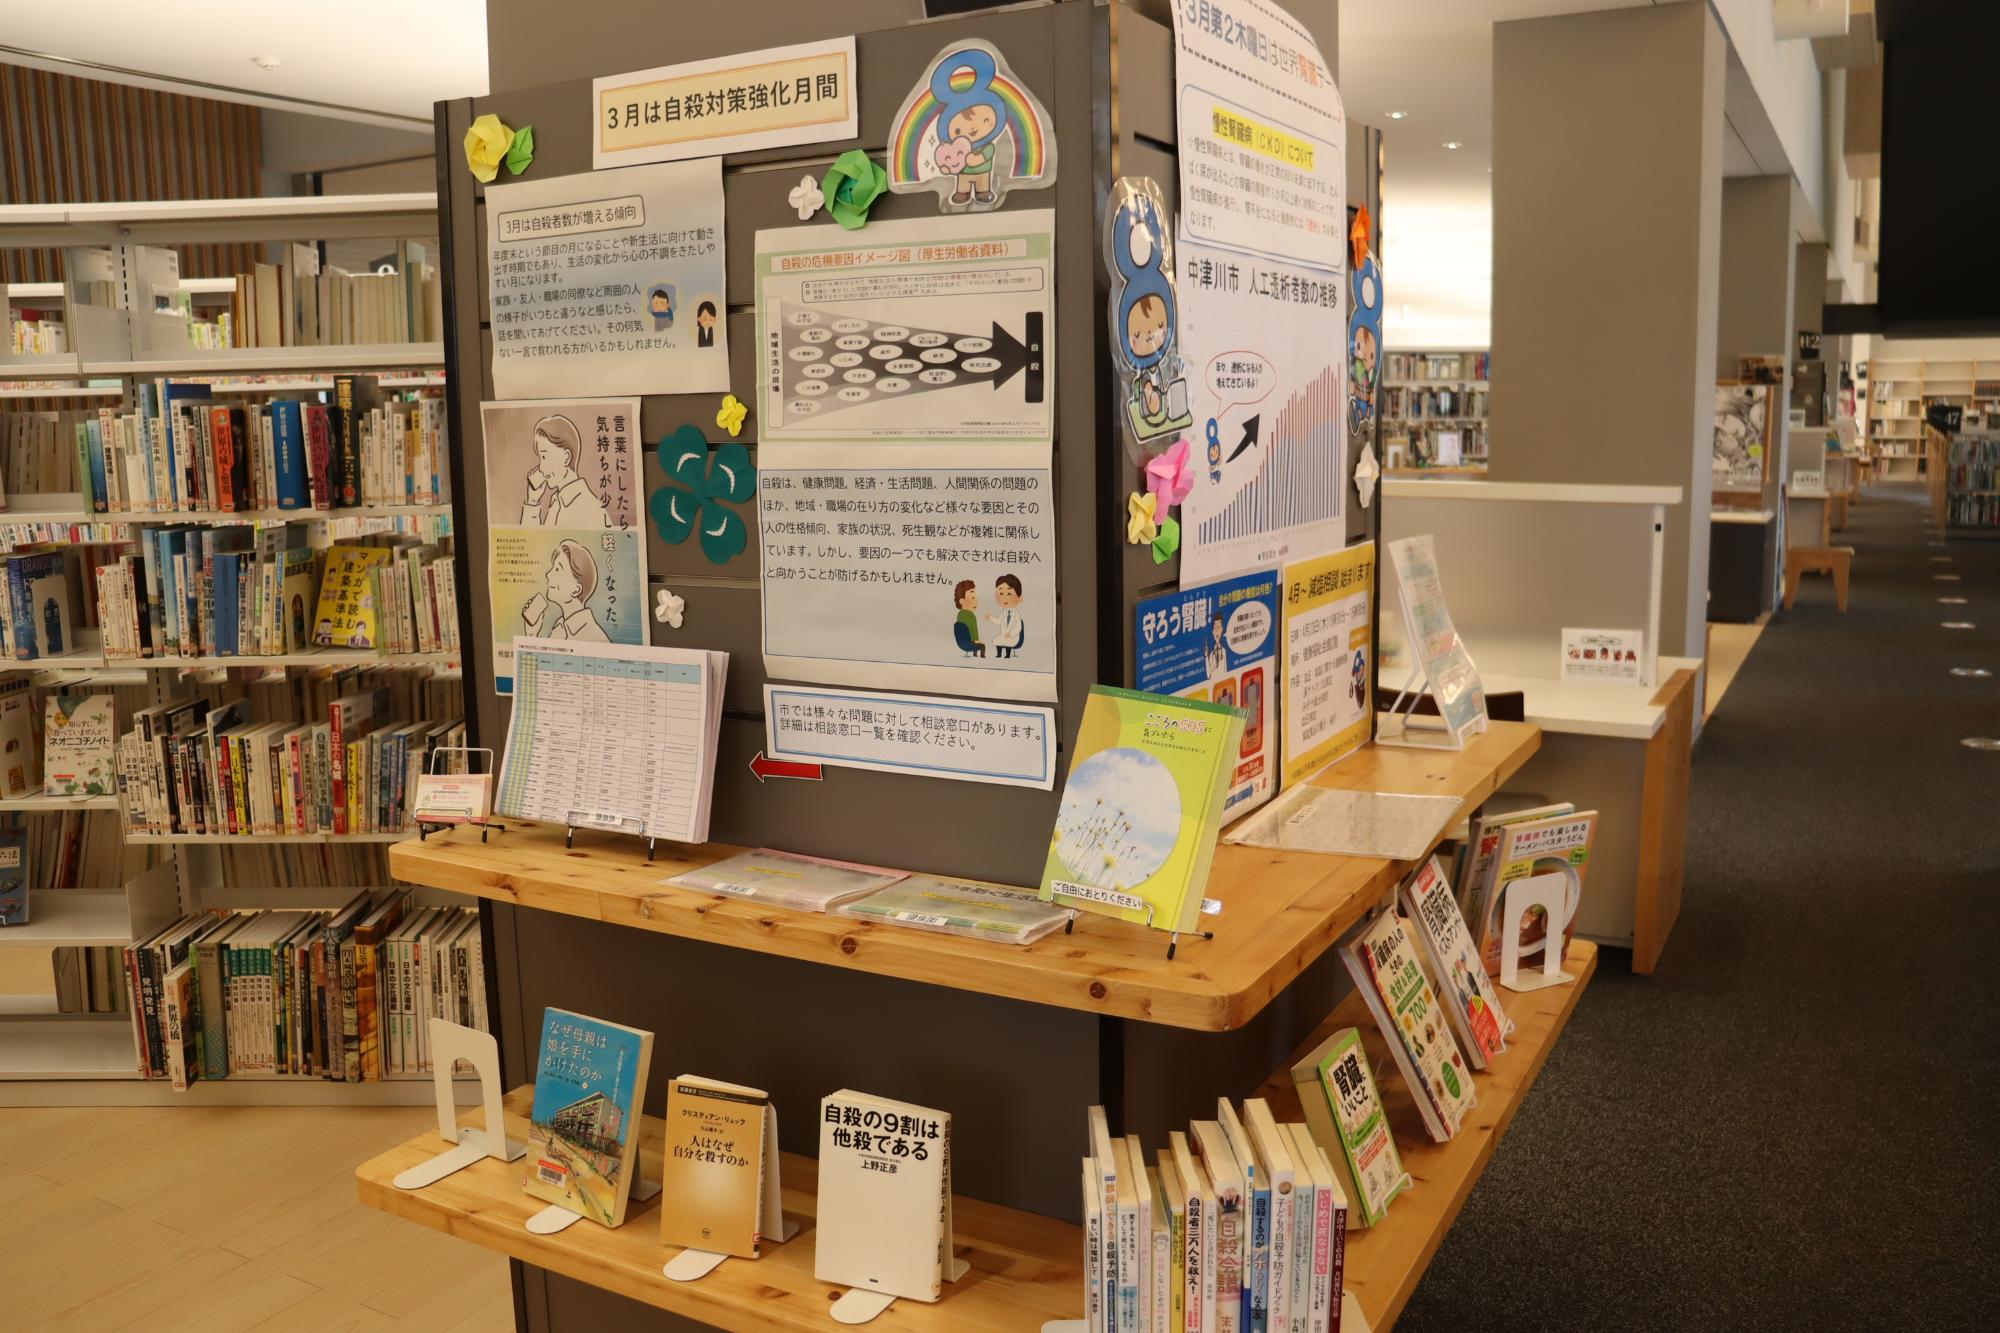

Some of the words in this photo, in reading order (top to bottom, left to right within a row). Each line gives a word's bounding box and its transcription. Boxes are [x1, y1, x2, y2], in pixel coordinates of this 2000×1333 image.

[506, 205, 636, 234] 3月は自殺者数が増える傾向
[781, 243, 1010, 271] 自殺の危機要因イメージ図（厚生労働省資料）
[495, 272, 563, 288] すい月になります。
[1187, 256, 1240, 294] 中津川市
[1249, 267, 1338, 310] 人工透析者数の推移
[496, 302, 637, 324] の様子がいつもと違うなと感じたら、
[498, 320, 643, 342] 話を聞いてあげてください。その何気
[770, 332, 780, 392] 地域生活の現場
[763, 498, 1040, 515] ほか、地域・職場の在り方の変化など様々な要因とその
[765, 521, 1040, 540] 人の性格傾向、家族の状況、死生観などが複雑に関係し
[766, 544, 1041, 564] ています。しかし、要因の一つでも解決できれば自殺へ
[346, 551, 368, 629] マンガで読む
[767, 566, 953, 586] と向かうことが防げるかもしれません。
[332, 561, 354, 629] 建築基準法
[779, 703, 1041, 742] 市では様々な問題に対して相談窓口があります。
[780, 717, 976, 751] 詳細は相談窓口一覧を確認ください。
[48, 736, 110, 747] ネオニコチノイド
[1053, 881, 1143, 908] ご自由におとりください
[1408, 996, 1427, 1025] 700
[549, 1020, 608, 1048] なぜ母親は
[546, 1038, 592, 1061] 娘を手に
[544, 1055, 602, 1081] かけたのか
[681, 1108, 746, 1126] クリスティアン・リュック
[824, 1103, 940, 1140] 自殺の9割は
[690, 1135, 735, 1151] 人はなぜ
[833, 1127, 928, 1161] 他殺である
[672, 1147, 749, 1168] 自分を殺すのか
[861, 1159, 898, 1174] 上野正彦
[1188, 1197, 1200, 1294] 自殺者三万人を救え！
[1314, 1190, 1330, 1274] いじめで死なせない
[1218, 1217, 1241, 1294] 自殺会議
[1272, 1199, 1287, 1314] 子どもの自殺予防ガイドブック
